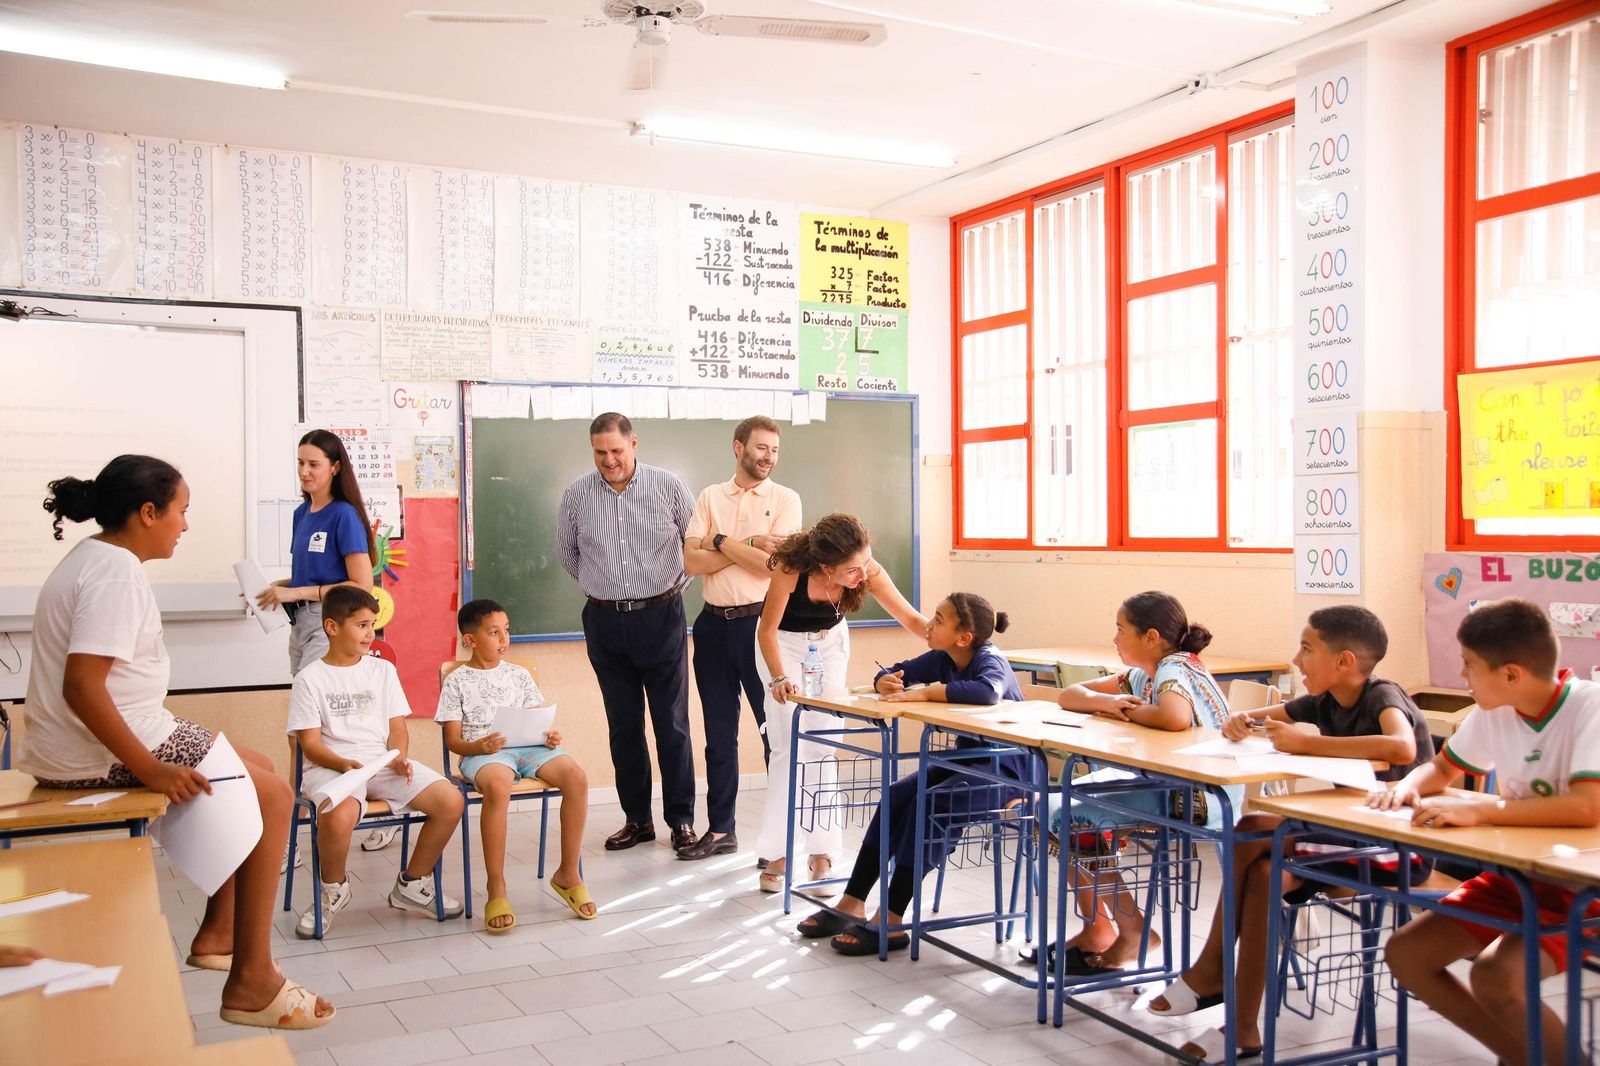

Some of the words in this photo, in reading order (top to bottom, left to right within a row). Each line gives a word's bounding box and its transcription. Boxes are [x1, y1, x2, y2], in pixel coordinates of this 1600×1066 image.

[1310, 76, 1348, 113] 100
[1320, 112, 1338, 124] cien
[25, 126, 33, 140] 3
[58, 129, 67, 143] 0
[86, 132, 95, 146] 0
[24, 139, 33, 153] 3
[58, 144, 65, 157] 1
[84, 146, 92, 160] 3
[138, 139, 146, 152] 4
[168, 143, 176, 156] 0
[194, 146, 202, 159] 0
[1309, 134, 1349, 170] 200
[26, 154, 34, 167] 3
[59, 158, 69, 171] 2
[86, 163, 96, 174] 6
[138, 153, 146, 166] 4
[169, 157, 175, 169] 1
[192, 159, 199, 172] 4
[240, 151, 247, 164] 5
[269, 153, 276, 166] 0
[293, 156, 300, 168] 0
[27, 168, 36, 182] 3
[61, 172, 69, 186] 3
[88, 175, 97, 188] 9
[344, 163, 351, 176] 6
[371, 164, 379, 177] 0
[392, 166, 400, 179] 0
[689, 203, 744, 223] Términos
[748, 210, 761, 225] de
[766, 211, 778, 226] la
[814, 220, 871, 238] Términos
[877, 227, 889, 241] de
[1307, 225, 1351, 240] trescientos
[704, 237, 731, 252] 538
[743, 241, 789, 255] Minuendo
[815, 237, 827, 252] la
[831, 240, 898, 260] multiplicación
[744, 255, 793, 270] Sustraendo
[1307, 249, 1347, 281] 400
[704, 271, 731, 286] 416
[743, 273, 795, 295] Diferencia
[831, 266, 853, 280] 325
[867, 270, 899, 283] Factor
[847, 281, 852, 290] 7
[867, 281, 899, 295] Factor
[1300, 281, 1353, 297] cuatrocientos
[822, 292, 852, 304] 2275
[867, 295, 906, 309] Producto
[689, 305, 731, 321] Prueba
[737, 308, 748, 323] de
[751, 309, 761, 323] la
[765, 311, 791, 324] resta
[803, 311, 852, 327] Dividendo
[860, 313, 897, 328] Divisor
[1309, 304, 1348, 336] 500
[667, 344, 673, 352] 8
[698, 330, 728, 343] 416
[738, 331, 791, 350] Diferencia
[821, 327, 850, 350] 37
[860, 327, 874, 350] 7
[1308, 336, 1351, 350] quinientos
[738, 346, 796, 360] Sustraendo
[698, 364, 729, 379] 538
[738, 365, 790, 379] Minuendo
[836, 352, 848, 374] 2
[859, 354, 871, 375] 5
[817, 375, 847, 388] Resto
[857, 379, 897, 391] Cociente
[1308, 360, 1347, 390] 600
[393, 388, 452, 409] Gritar
[1307, 392, 1351, 404] seiscientos
[1480, 387, 1520, 412] Can
[1533, 381, 1547, 405] I
[1495, 418, 1528, 443] the
[1306, 427, 1345, 457] 700
[1306, 460, 1349, 470] setecientos
[1521, 440, 1588, 480] please
[1306, 488, 1347, 516] 800
[1304, 518, 1352, 529] ochocientos
[1307, 549, 1348, 576] 900
[1481, 556, 1512, 582] EL
[1305, 580, 1354, 590] novecientos
[329, 700, 354, 710] Club
